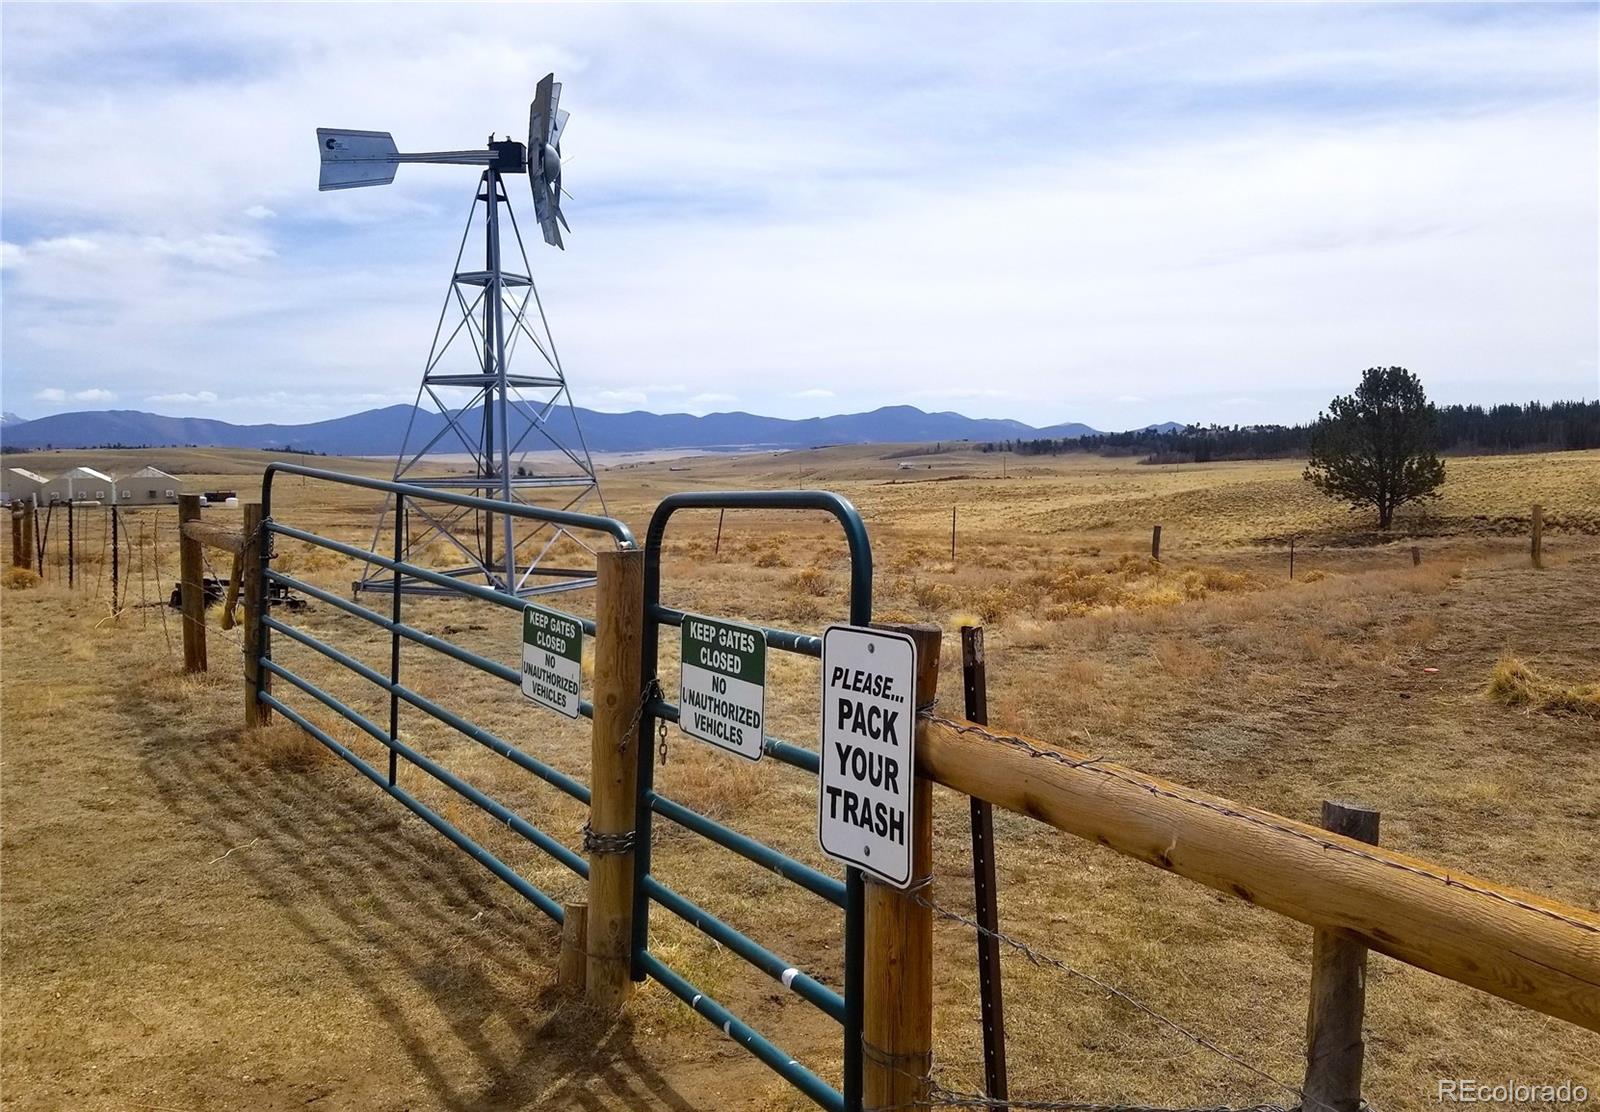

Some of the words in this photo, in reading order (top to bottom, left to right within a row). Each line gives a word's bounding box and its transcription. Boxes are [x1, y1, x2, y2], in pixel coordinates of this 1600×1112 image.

[529, 610, 550, 630] KEEP
[551, 616, 576, 639] GATES
[689, 621, 717, 644] KEEP
[718, 628, 755, 654] GATES
[536, 631, 566, 654] CLOSED
[544, 653, 556, 669] NO
[700, 646, 742, 674] CLOSED
[523, 660, 578, 696] UNAUTHORIZED
[532, 680, 567, 708] VEHICLES
[711, 675, 727, 695] NO
[831, 666, 904, 703] PLEASE...
[682, 686, 761, 729] UNAUTHORIZED
[838, 698, 899, 746] PACK
[694, 712, 743, 746] VEHICLES
[835, 742, 899, 794] YOUR
[826, 785, 904, 846] TRASH
